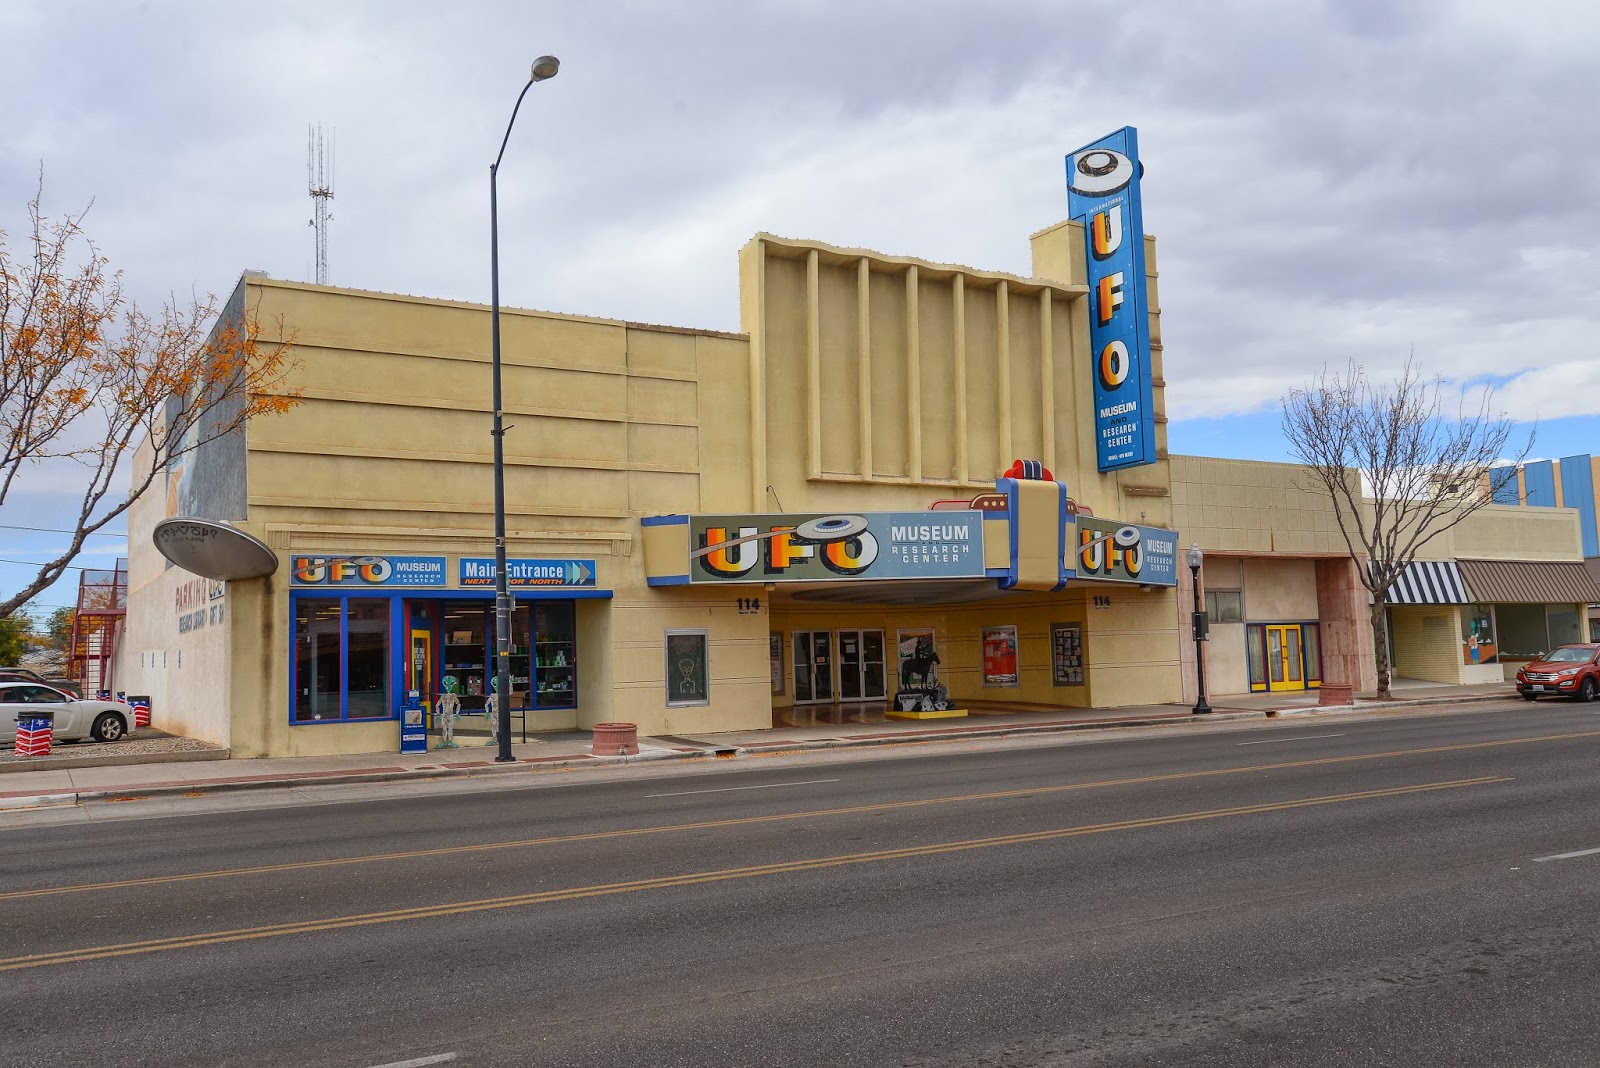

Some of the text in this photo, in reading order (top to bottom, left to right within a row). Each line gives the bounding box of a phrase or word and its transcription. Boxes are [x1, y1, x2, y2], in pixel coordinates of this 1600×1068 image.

[1091, 204, 1130, 390] UFO
[1100, 401, 1137, 418] MUSEUM
[1111, 416, 1128, 425] AND
[1103, 423, 1137, 438] RESEARCH
[1107, 435, 1132, 448] CENTER
[891, 525, 969, 541] MUSEUM
[702, 525, 879, 577] UFO
[891, 545, 969, 555] RESEARCH
[1081, 528, 1144, 577] UFO
[1147, 539, 1173, 554] MUSEUM
[902, 554, 959, 563] CENTER
[1147, 556, 1173, 565] RESEARCH
[294, 557, 393, 584] UFO
[396, 562, 441, 572] MUSEUM
[465, 561, 564, 578] Main Entrance
[1150, 564, 1170, 572] CENTER
[737, 597, 760, 610] 114
[1093, 595, 1111, 606] 114
